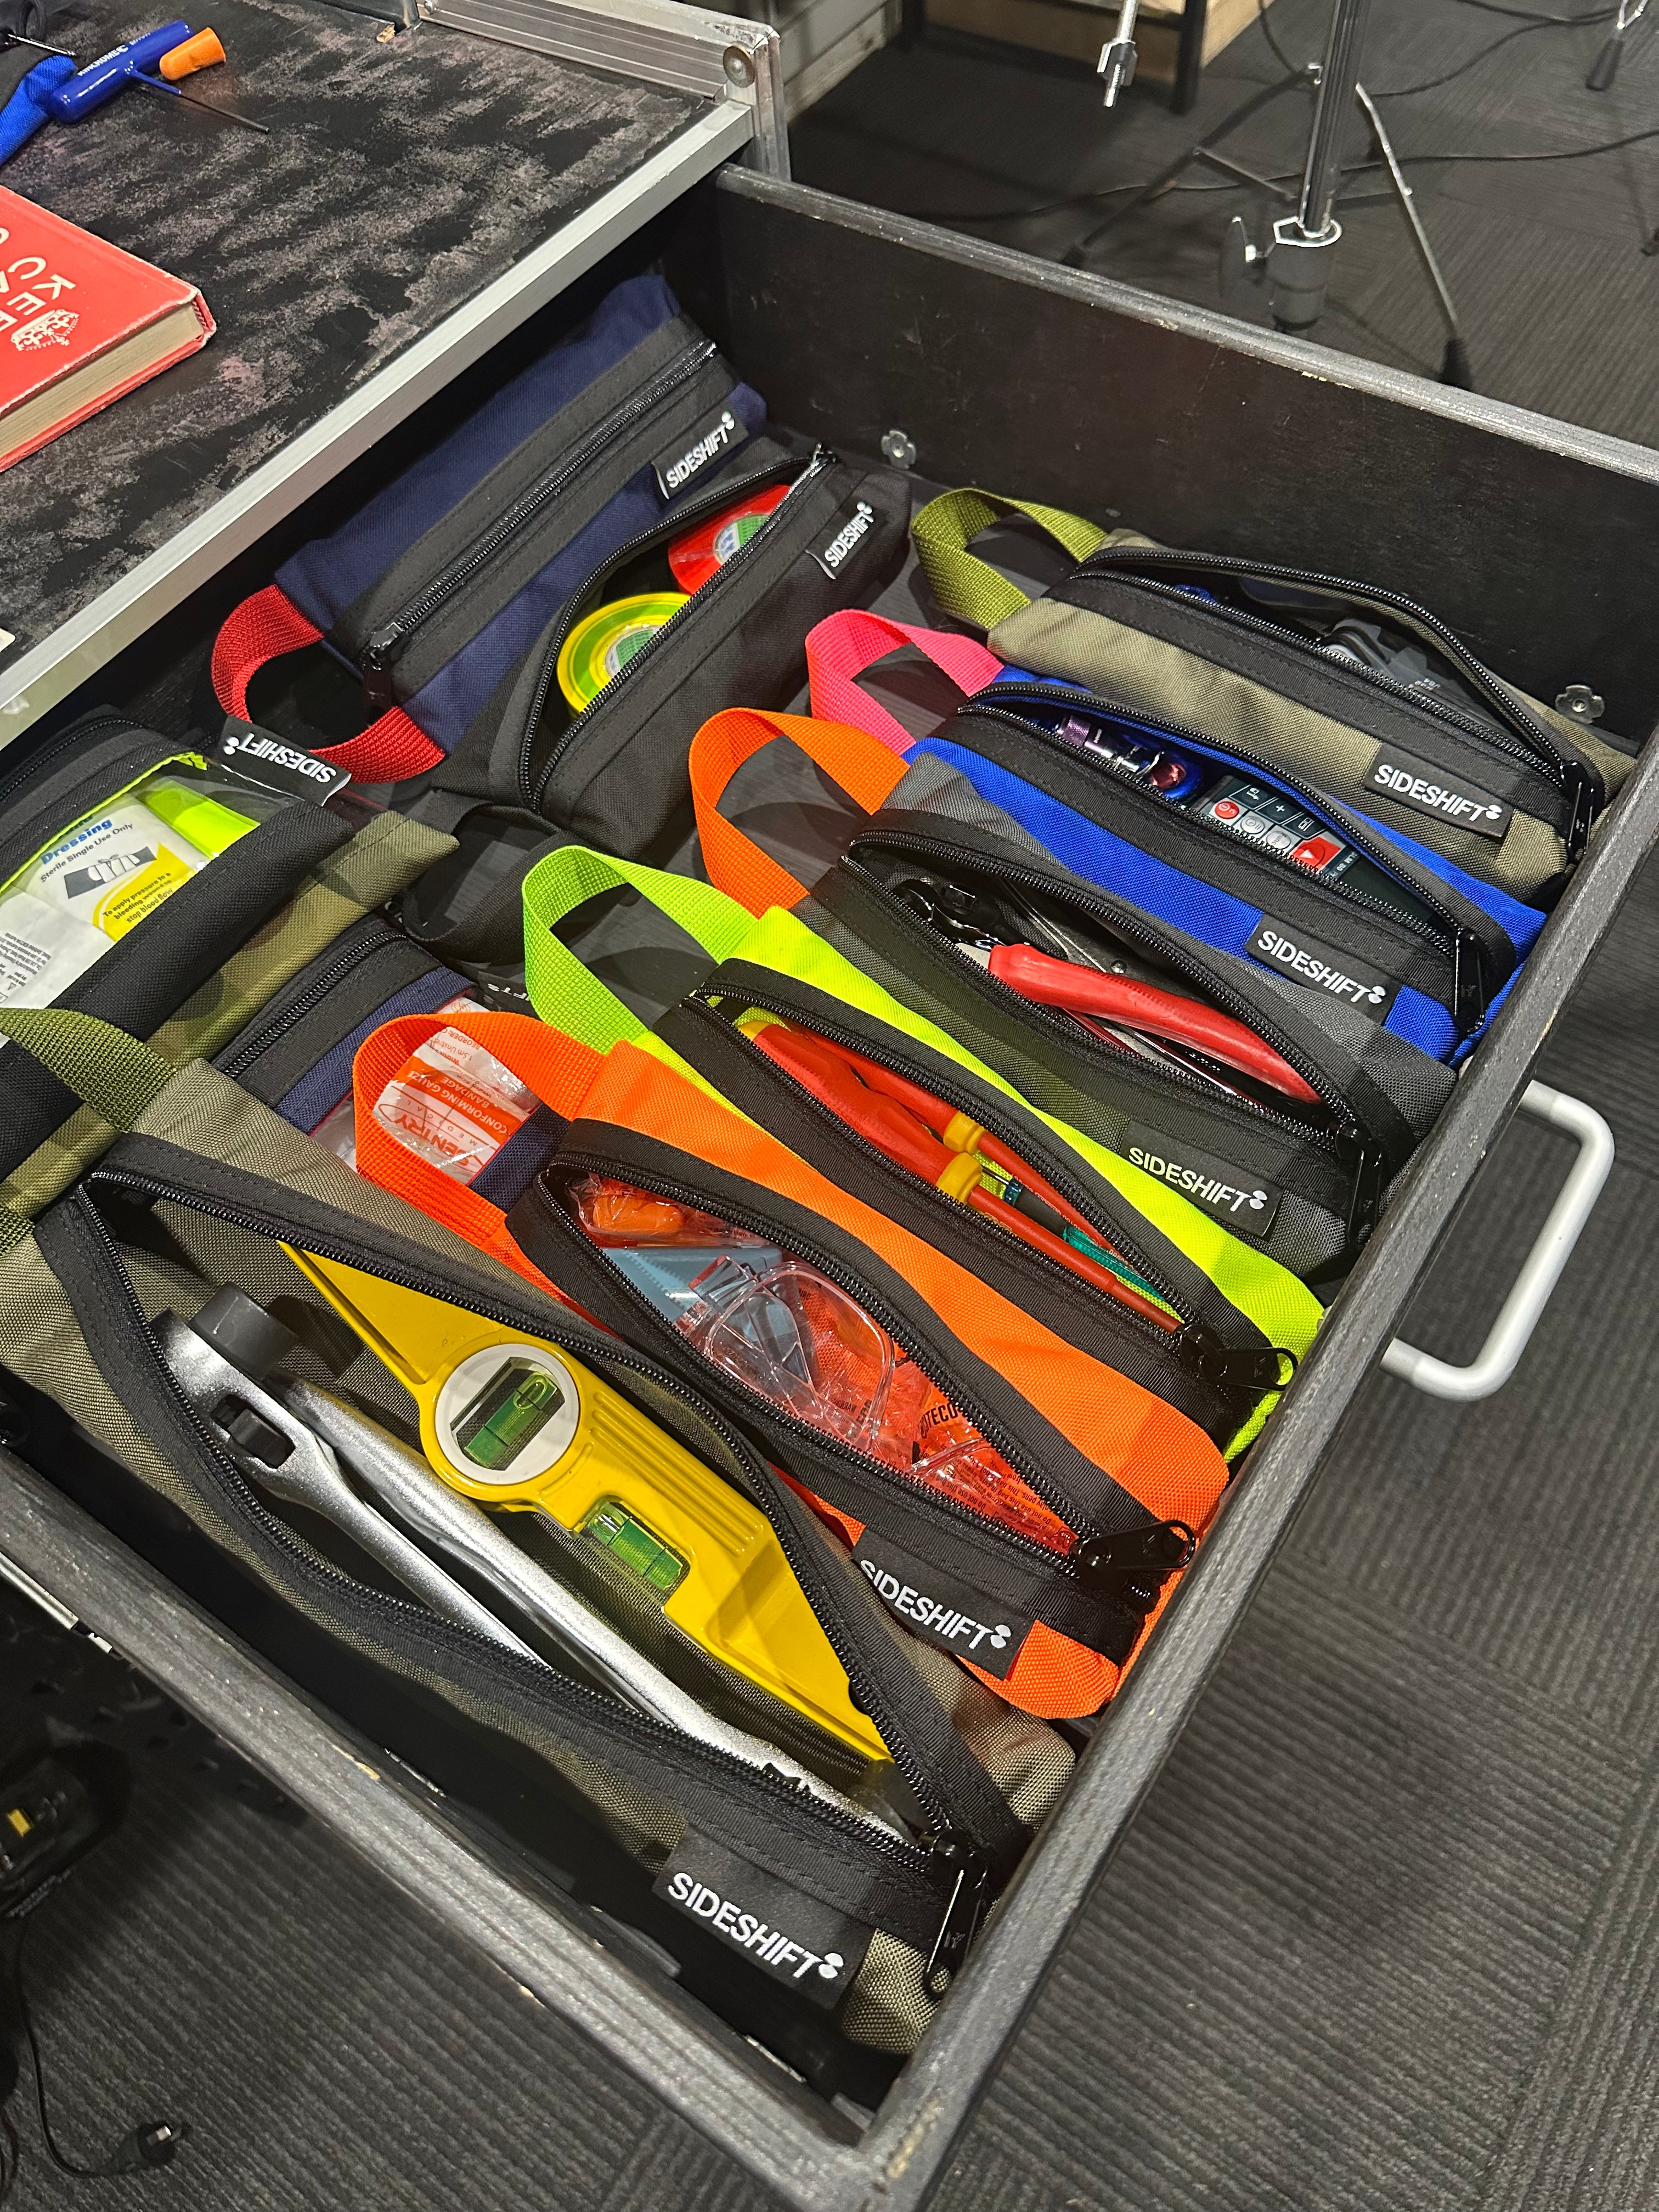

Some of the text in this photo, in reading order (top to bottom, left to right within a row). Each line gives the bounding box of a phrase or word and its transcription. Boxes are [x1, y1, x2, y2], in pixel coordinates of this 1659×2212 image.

[666, 424, 729, 488] SIDESHIFT
[824, 511, 874, 567] SIDESHIFT
[236, 732, 336, 783] SIDESHIFT
[1374, 764, 1488, 821] SIDESHIFT
[41, 819, 113, 865] Dressing
[41, 823, 133, 883] Sterile Single Use Only
[112, 898, 131, 912] apply
[130, 882, 157, 901] pressure
[157, 876, 166, 884] to
[114, 899, 144, 920] bleeding
[126, 912, 142, 923] stop
[141, 897, 160, 915] blood
[1258, 930, 1372, 1003] SIDESHIFT
[407, 1070, 440, 1093] GAUZE
[442, 1077, 491, 1109] BANDAGE
[407, 1099, 478, 1147] MEDICAL
[441, 1089, 508, 1135] CONFORMING
[394, 1114, 470, 1166] SENTRY
[1128, 1147, 1252, 1212] SIDESHIFT
[956, 1488, 968, 1499] use
[966, 1494, 978, 1505] not
[976, 1500, 986, 1510] Do
[997, 1488, 1009, 1500] bag
[1006, 1484, 1020, 1496] This
[1007, 1495, 1021, 1508] this
[1020, 1503, 1032, 1514] use
[1031, 1509, 1042, 1520] not
[1041, 1515, 1052, 1525] Do
[860, 1560, 994, 1649] SIDESHIFT
[668, 1872, 823, 1978] SIDESHIFT
